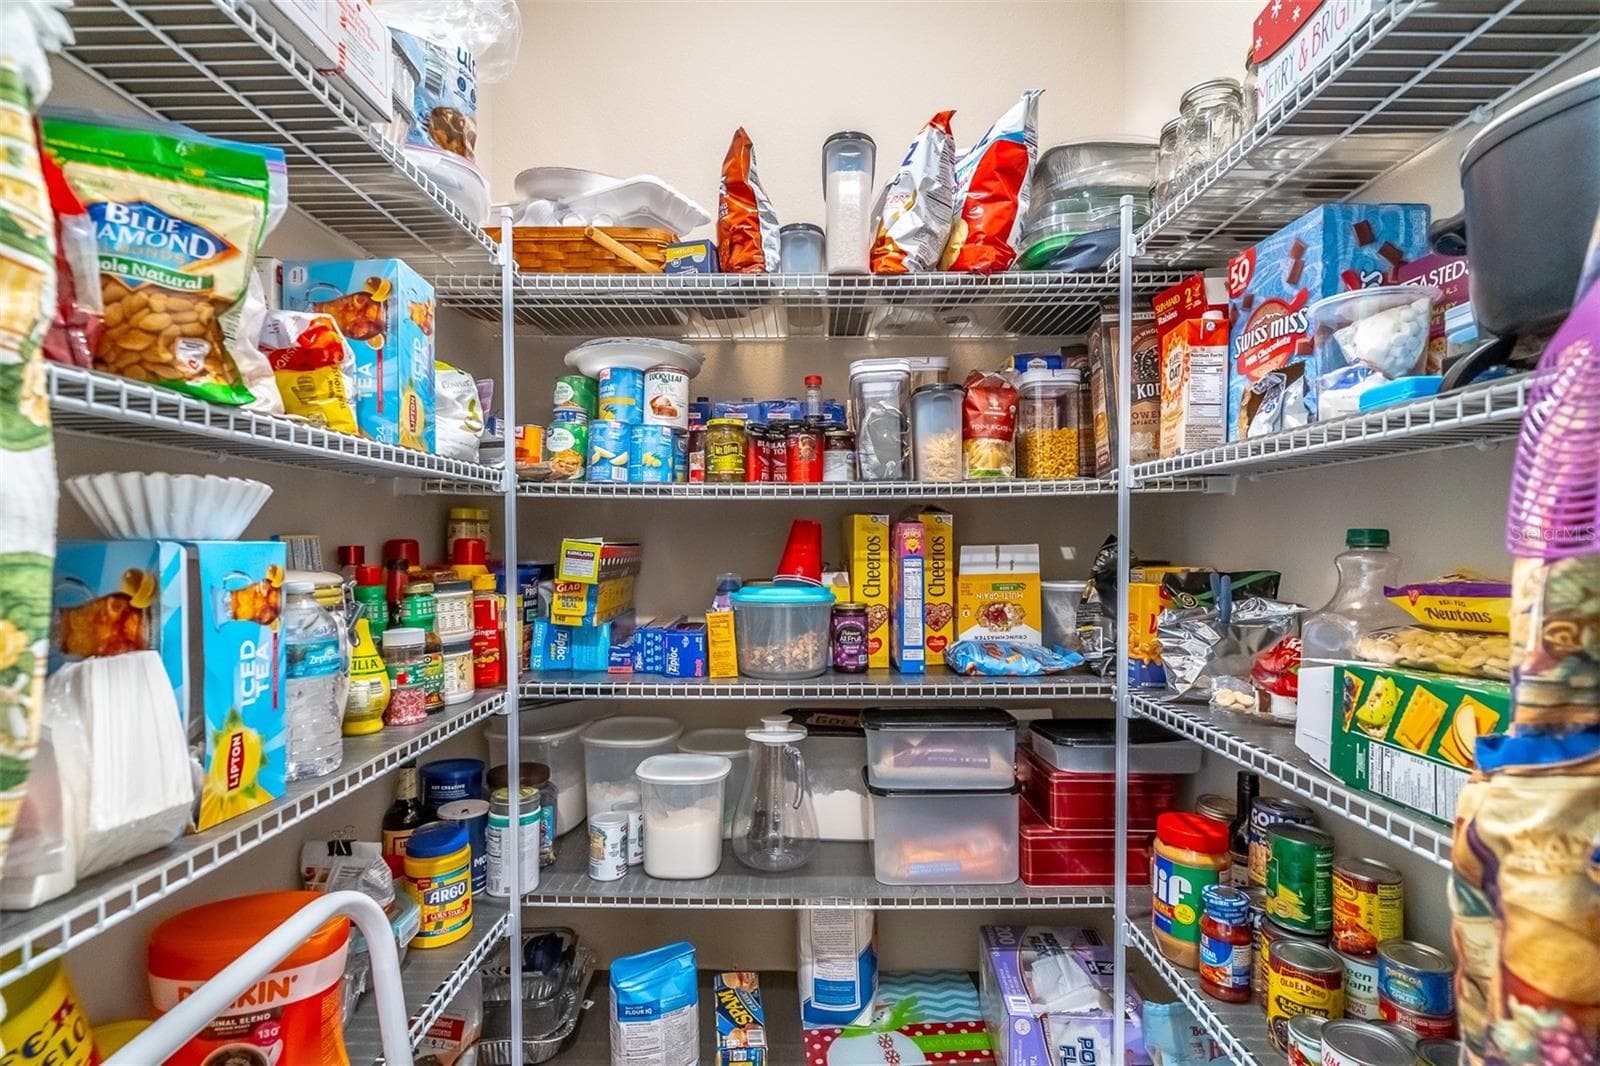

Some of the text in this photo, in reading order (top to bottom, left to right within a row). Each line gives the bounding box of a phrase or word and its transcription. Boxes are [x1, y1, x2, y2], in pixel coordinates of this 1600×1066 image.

[105, 203, 181, 233] BLUE
[98, 225, 216, 259] AMOND
[99, 257, 202, 289] ole Natural
[1231, 259, 1249, 289] 50
[1235, 307, 1308, 358] SWISS MISS
[863, 536, 881, 598] Cheerios
[928, 536, 945, 597] Cheerios
[557, 583, 580, 592] GLAD
[1424, 607, 1492, 623] Newtons
[557, 631, 568, 660] Ziploc
[241, 640, 256, 707] ICED
[255, 650, 269, 697] TEA
[351, 658, 378, 669] ILIA
[230, 736, 241, 787] LIPTON
[429, 882, 466, 904] ARGO
[1346, 969, 1372, 983] een
[1346, 981, 1373, 994] iant
[178, 975, 298, 1009] DKIN'
[718, 989, 753, 1024] SPAM
[210, 1013, 271, 1027] GINAL BLEND
[258, 1028, 278, 1040] 130
